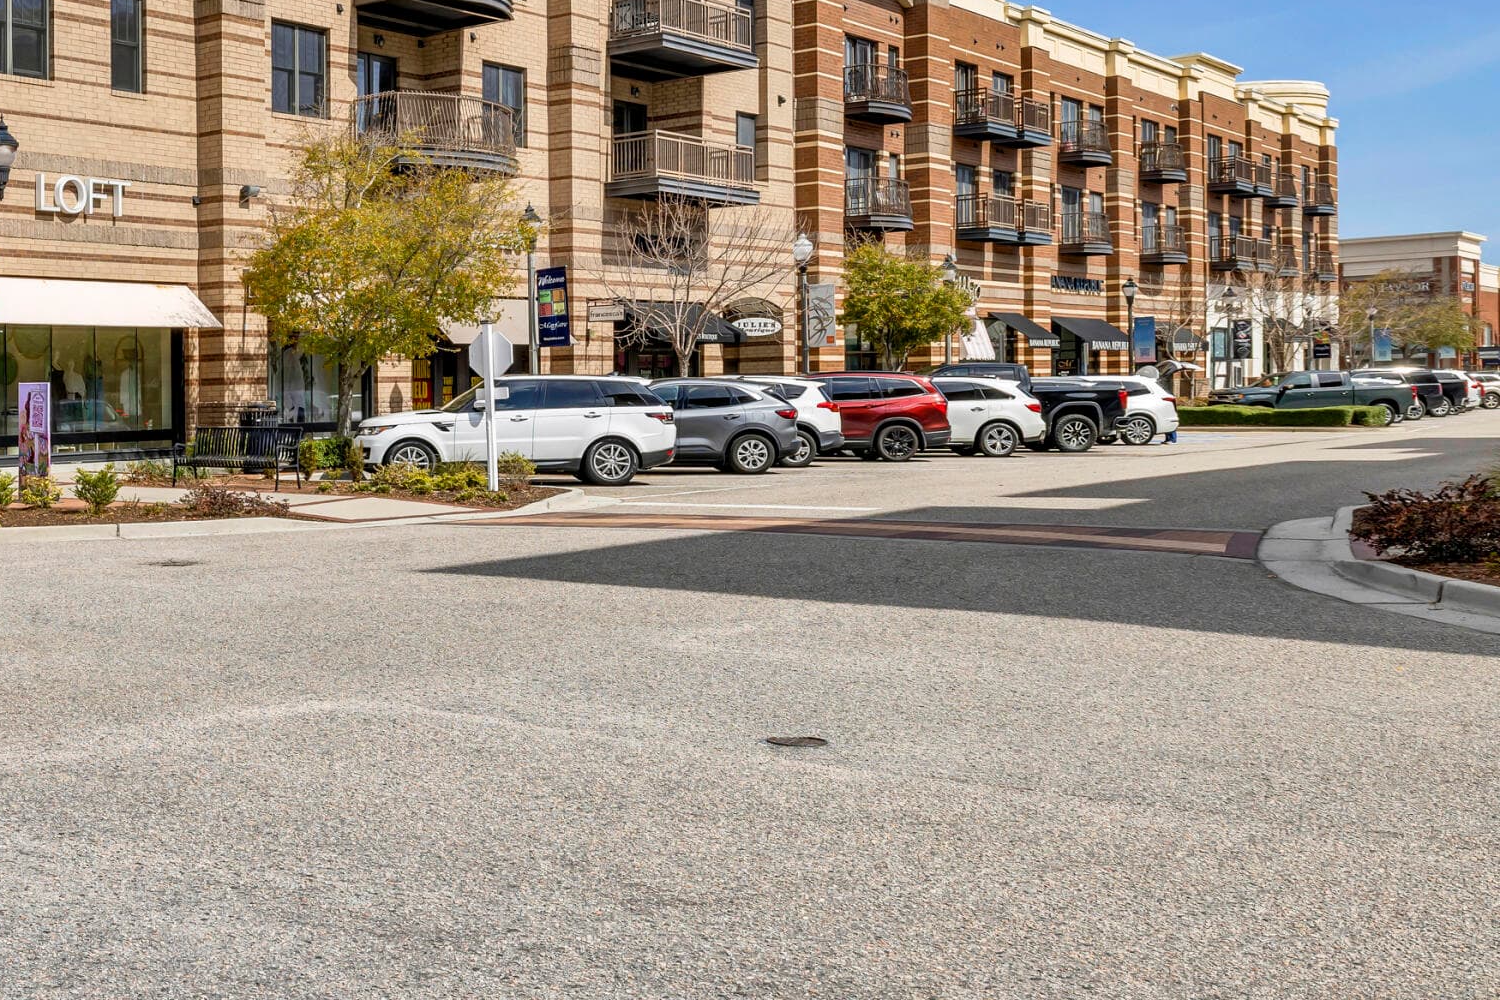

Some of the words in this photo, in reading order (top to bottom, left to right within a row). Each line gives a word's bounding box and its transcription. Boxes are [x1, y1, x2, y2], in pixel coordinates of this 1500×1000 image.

[35, 173, 132, 217] LOFT
[1380, 282, 1430, 293] TAYOR
[1112, 341, 1129, 350] REPUBLI
